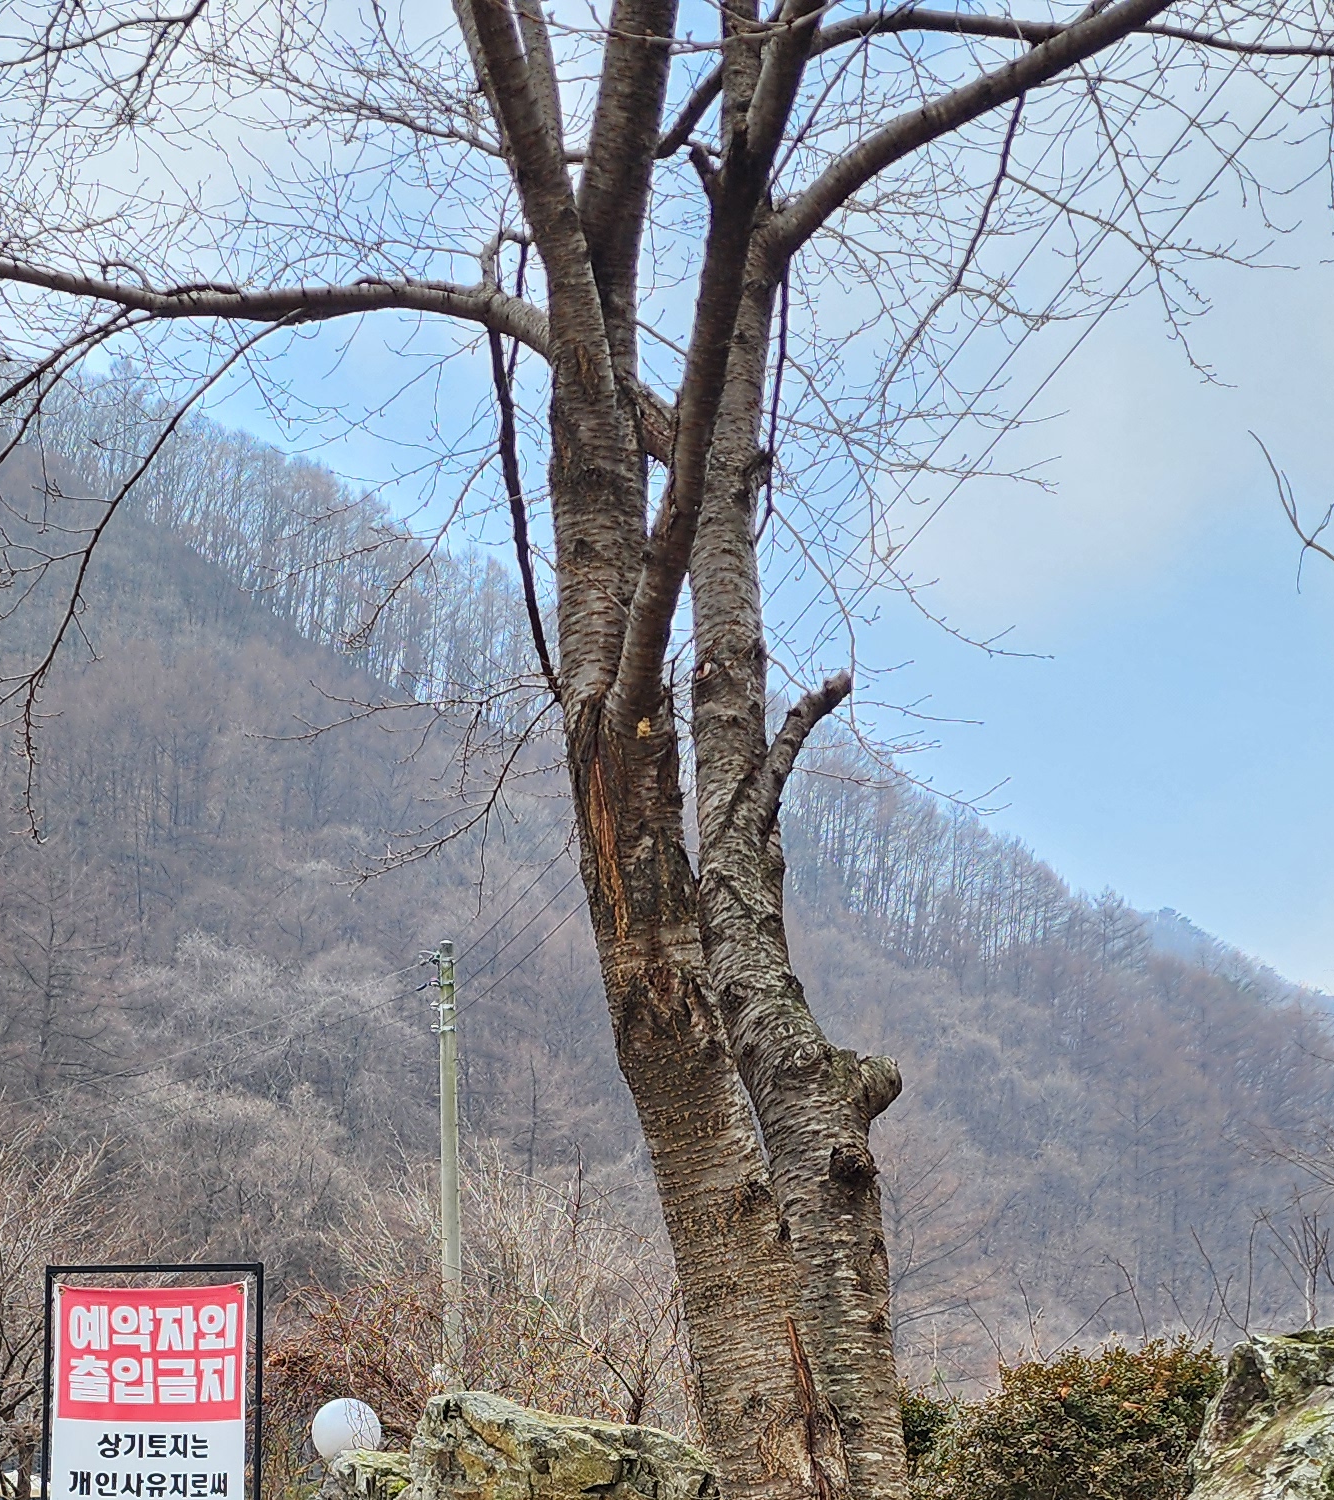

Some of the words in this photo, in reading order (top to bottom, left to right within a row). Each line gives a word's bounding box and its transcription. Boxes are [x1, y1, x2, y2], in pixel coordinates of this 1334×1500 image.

[69, 1303, 238, 1352] 예약자외
[69, 1354, 236, 1404] 출입금지
[97, 1433, 209, 1459] 상기토지는
[68, 1470, 228, 1497] 개인사유지로써
